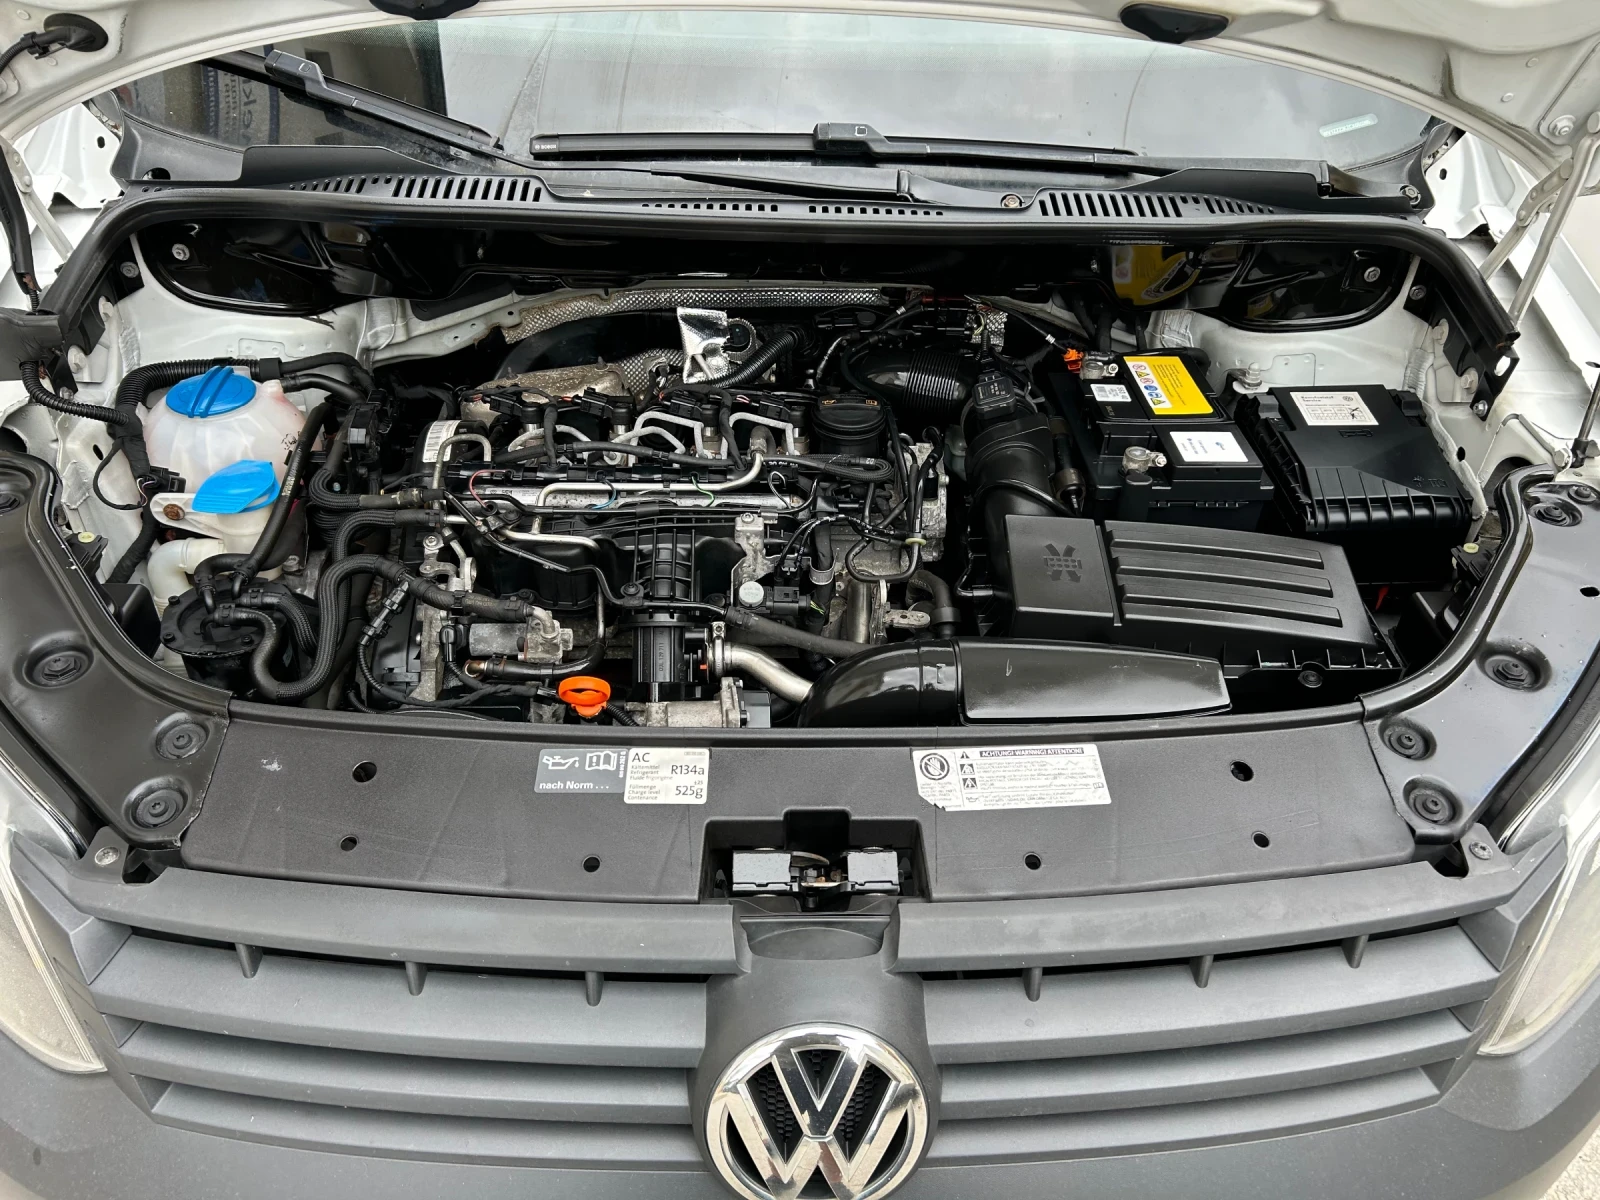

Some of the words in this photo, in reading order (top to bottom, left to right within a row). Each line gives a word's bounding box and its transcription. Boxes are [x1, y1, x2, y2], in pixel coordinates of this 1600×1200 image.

[632, 752, 651, 762] AC
[671, 764, 705, 775] R134a
[539, 781, 564, 790] nach
[565, 781, 594, 789] Norm
[675, 785, 704, 799] 525g
